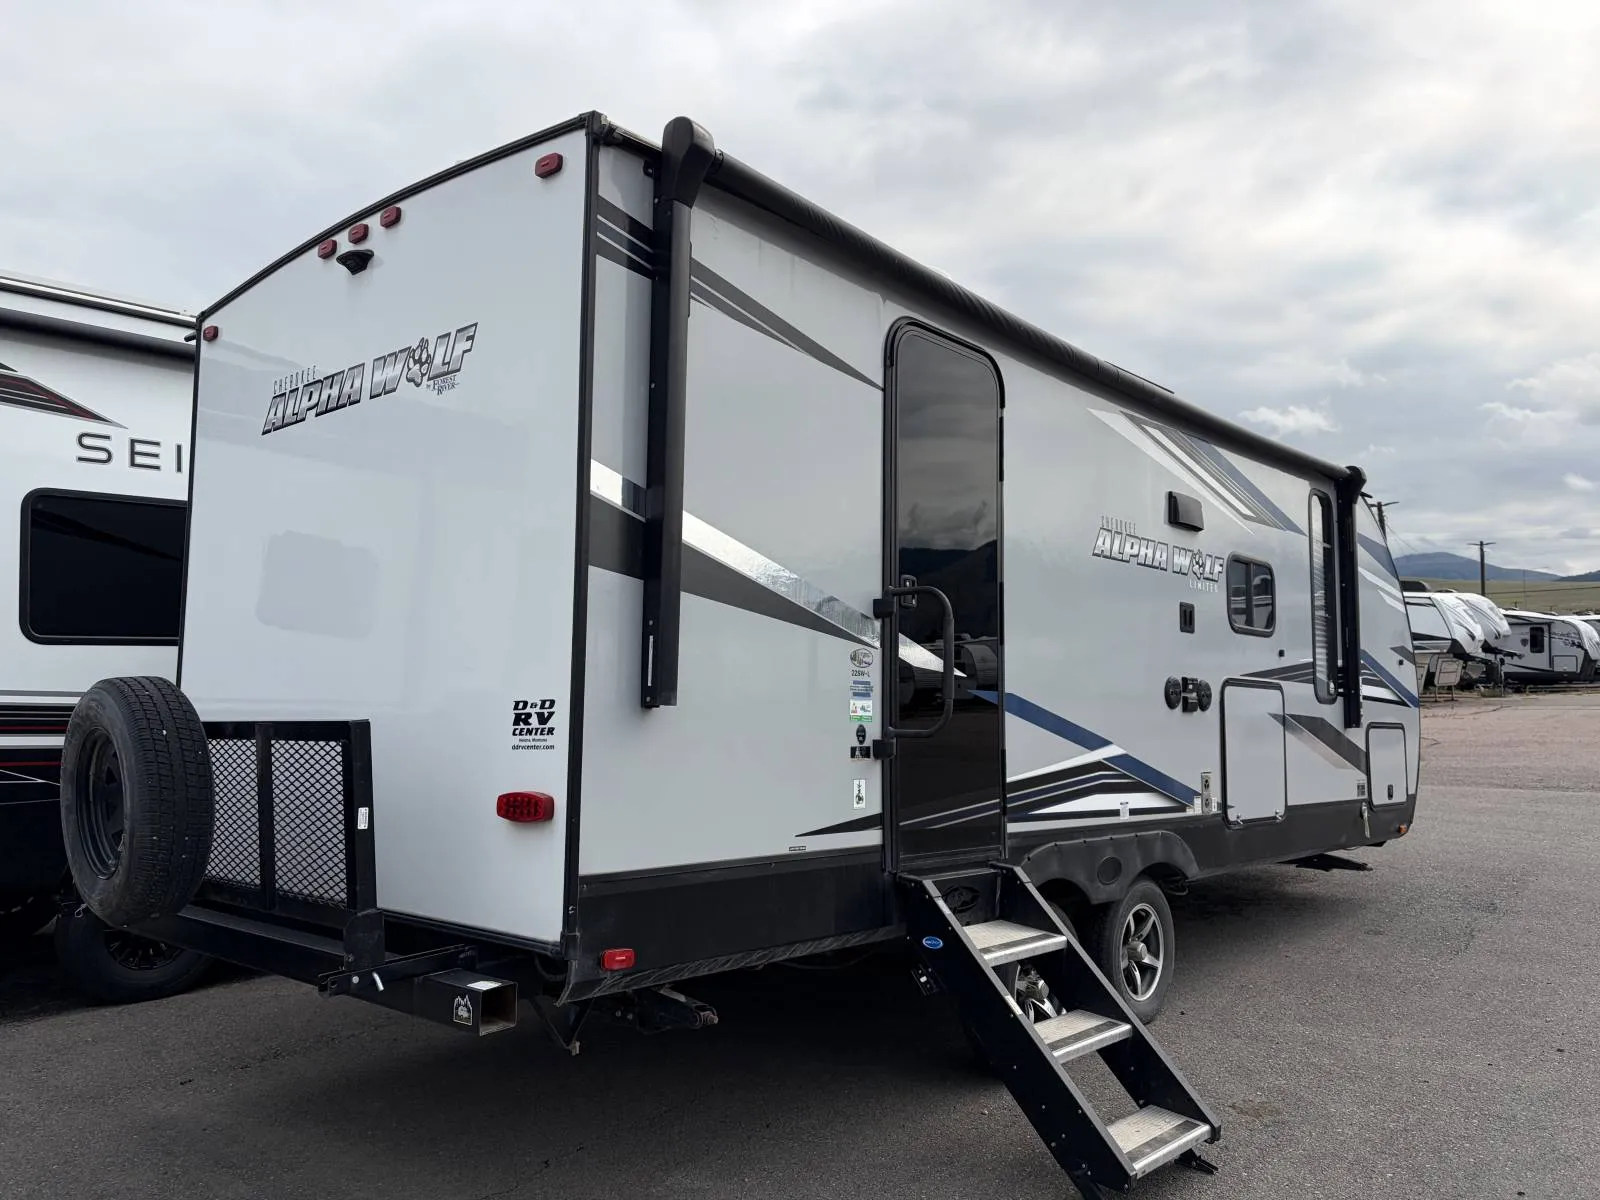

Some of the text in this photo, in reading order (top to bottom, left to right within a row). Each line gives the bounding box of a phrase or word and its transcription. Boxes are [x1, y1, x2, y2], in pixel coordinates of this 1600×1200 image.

[261, 362, 365, 436] ALPHA
[77, 432, 182, 473] SEI
[1092, 527, 1168, 571] ALPHA
[512, 699, 556, 711] D&D
[512, 711, 556, 726] RV
[511, 727, 556, 736] CENTER
